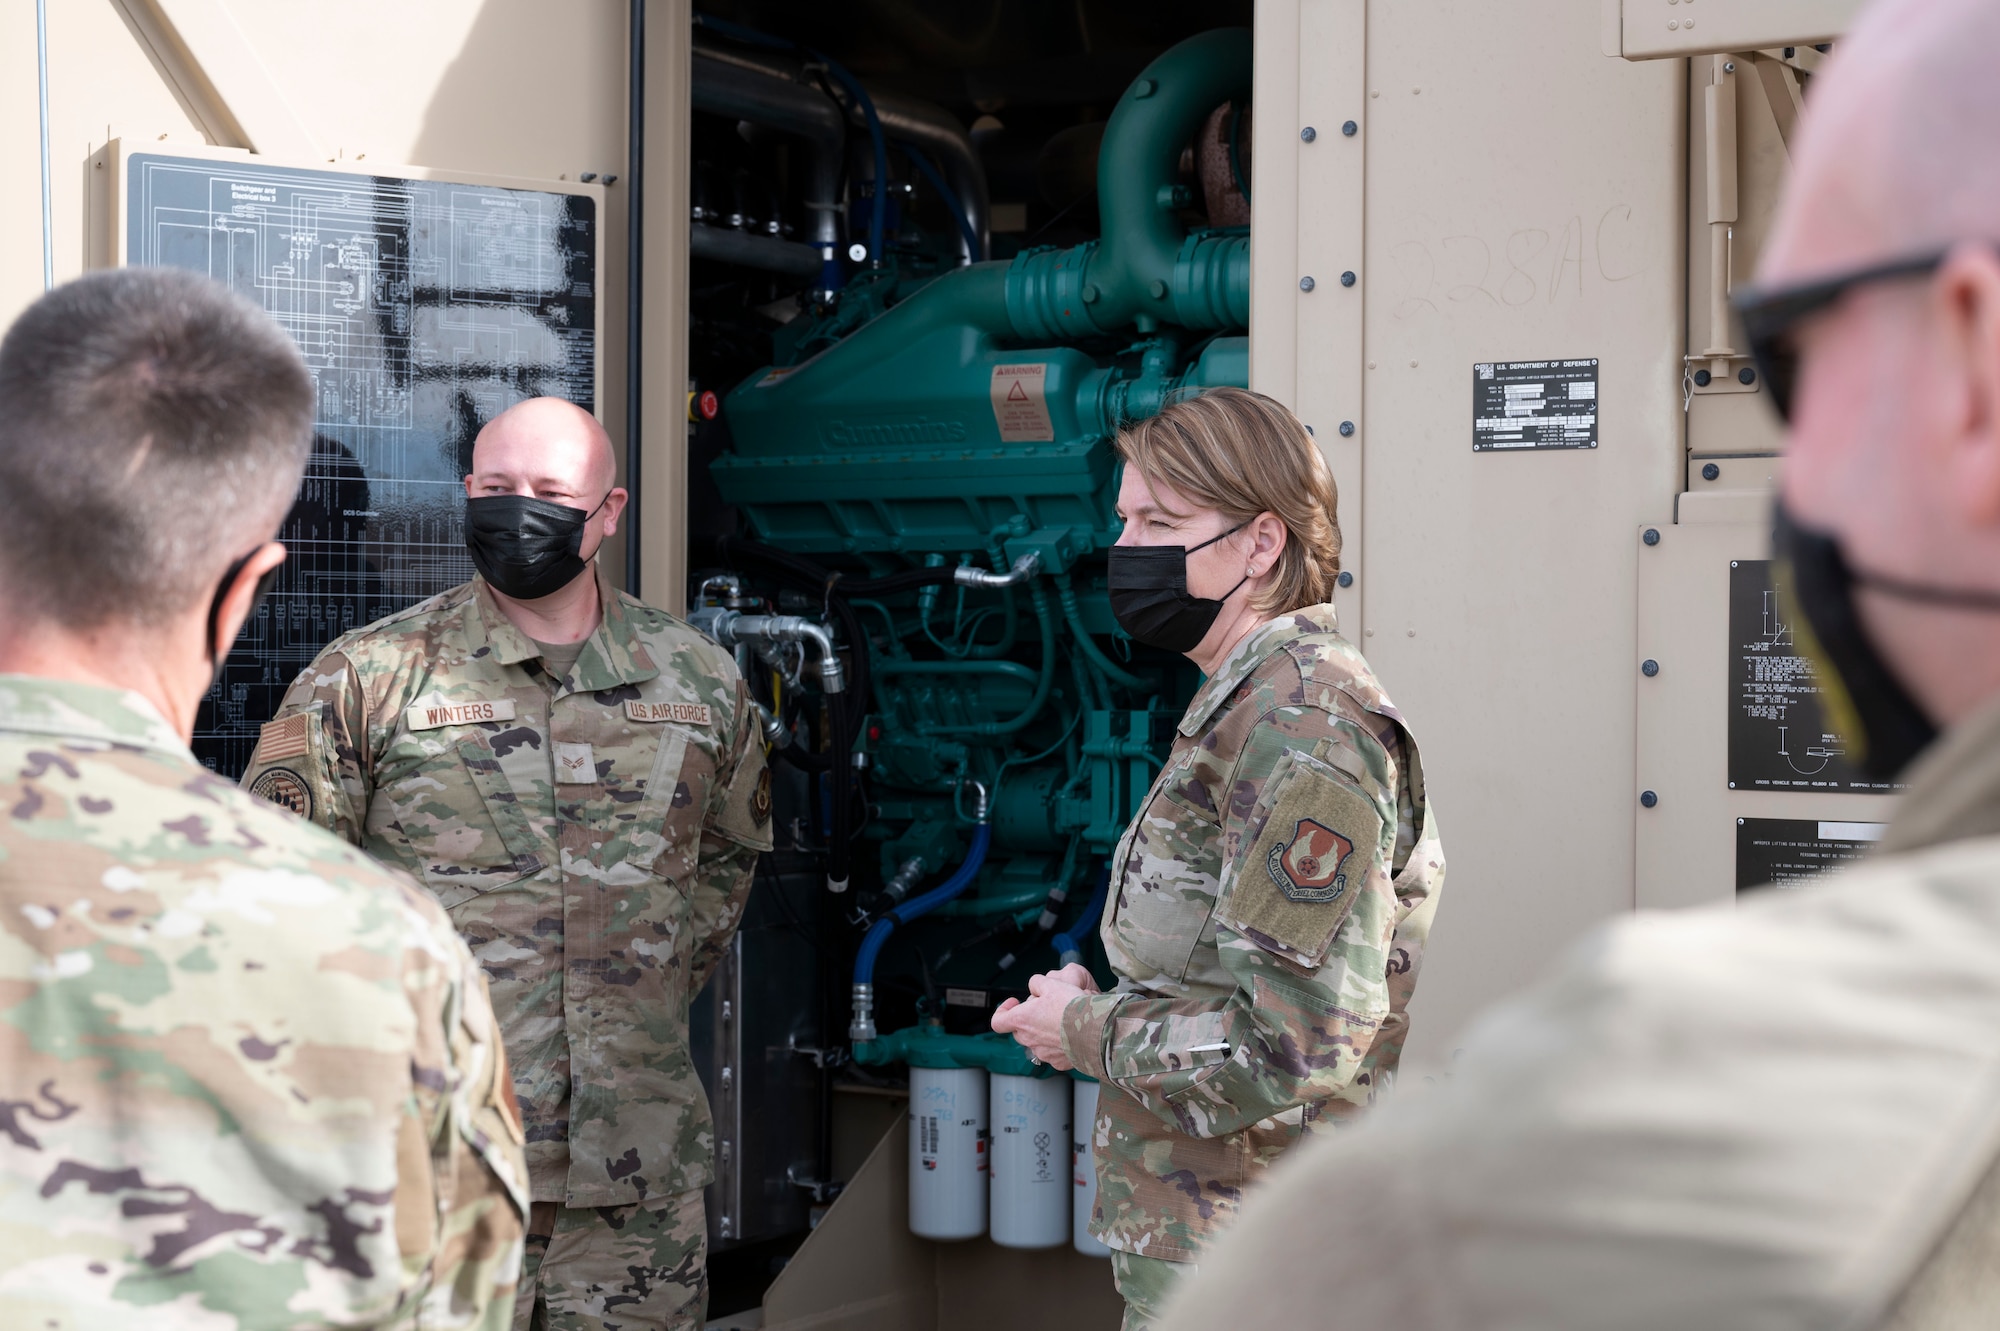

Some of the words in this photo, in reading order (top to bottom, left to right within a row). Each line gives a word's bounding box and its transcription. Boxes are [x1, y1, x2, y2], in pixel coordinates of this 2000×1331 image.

[230, 184, 264, 194] Switchgear
[231, 192, 260, 201] Electrical
[481, 198, 506, 206] Electrical
[1004, 367, 1041, 375] WARNING
[830, 419, 966, 443] Cummins
[426, 704, 494, 725] WINTERS
[630, 702, 649, 718] U.S.
[652, 704, 674, 719] AIR
[674, 705, 708, 722] FORCE
[271, 771, 298, 783] MAINTENANCE
[1310, 884, 1337, 898] COMMAND
